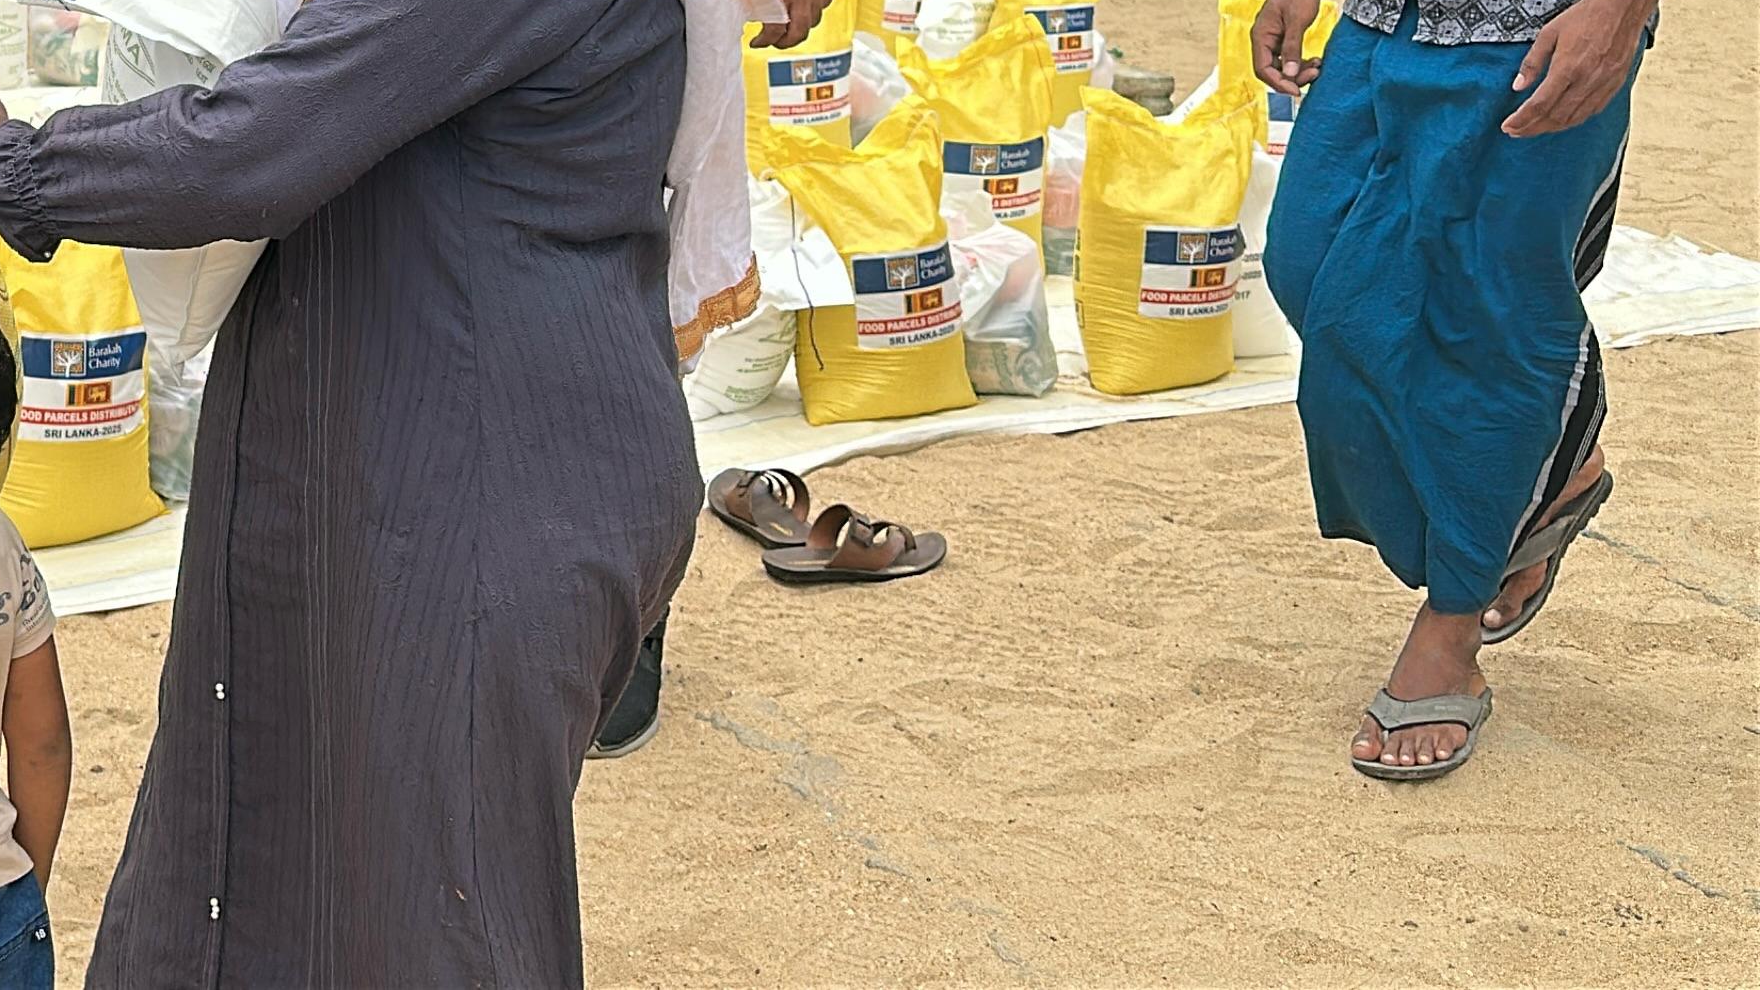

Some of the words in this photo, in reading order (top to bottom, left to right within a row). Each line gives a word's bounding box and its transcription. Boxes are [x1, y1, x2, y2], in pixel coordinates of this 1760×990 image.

[1142, 291, 1168, 301] FOOD
[1169, 307, 1185, 316] SRI
[859, 322, 885, 332] FOOD
[887, 318, 926, 331] PARCELS
[889, 336, 906, 346] SRI
[88, 342, 123, 358] Barakah
[88, 356, 121, 370] Charity
[21, 410, 42, 421] OOD
[44, 411, 88, 423] PARCELS
[44, 429, 63, 439] SRI
[65, 424, 122, 439] LANKA-2025
